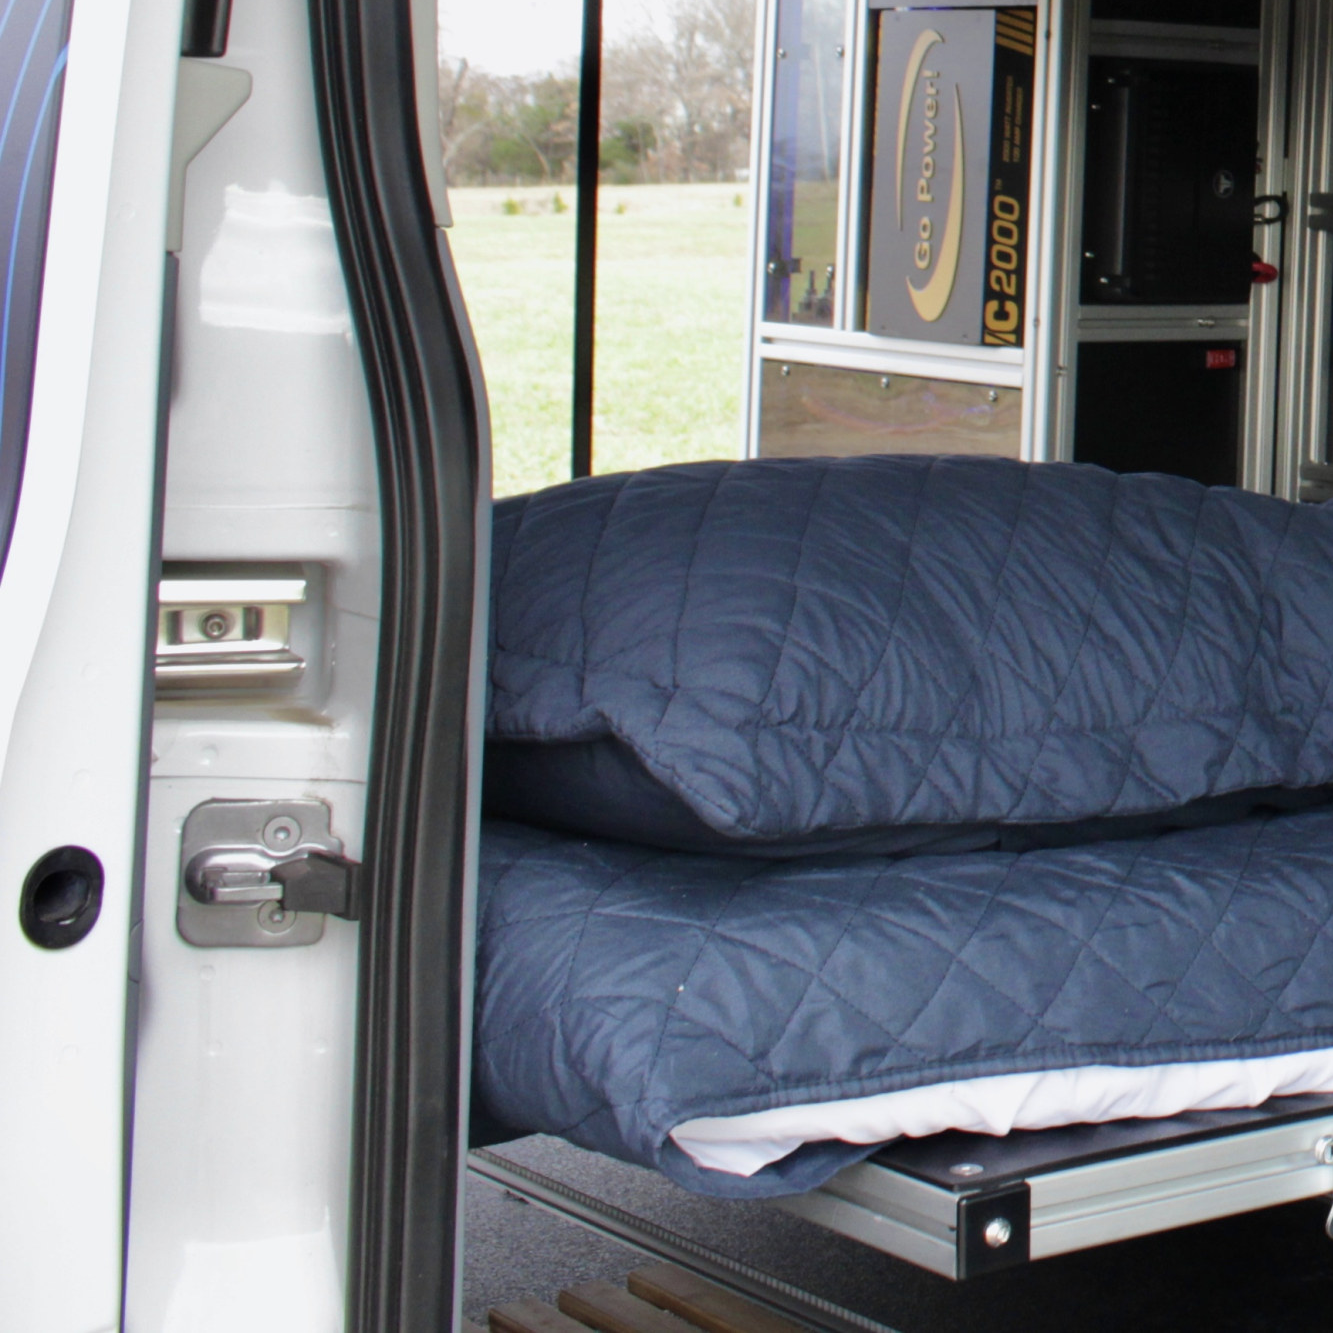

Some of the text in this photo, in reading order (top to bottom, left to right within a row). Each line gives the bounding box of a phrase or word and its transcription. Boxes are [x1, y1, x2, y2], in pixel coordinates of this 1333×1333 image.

[914, 69, 940, 270] Go Power!
[989, 194, 1021, 297] 2000
